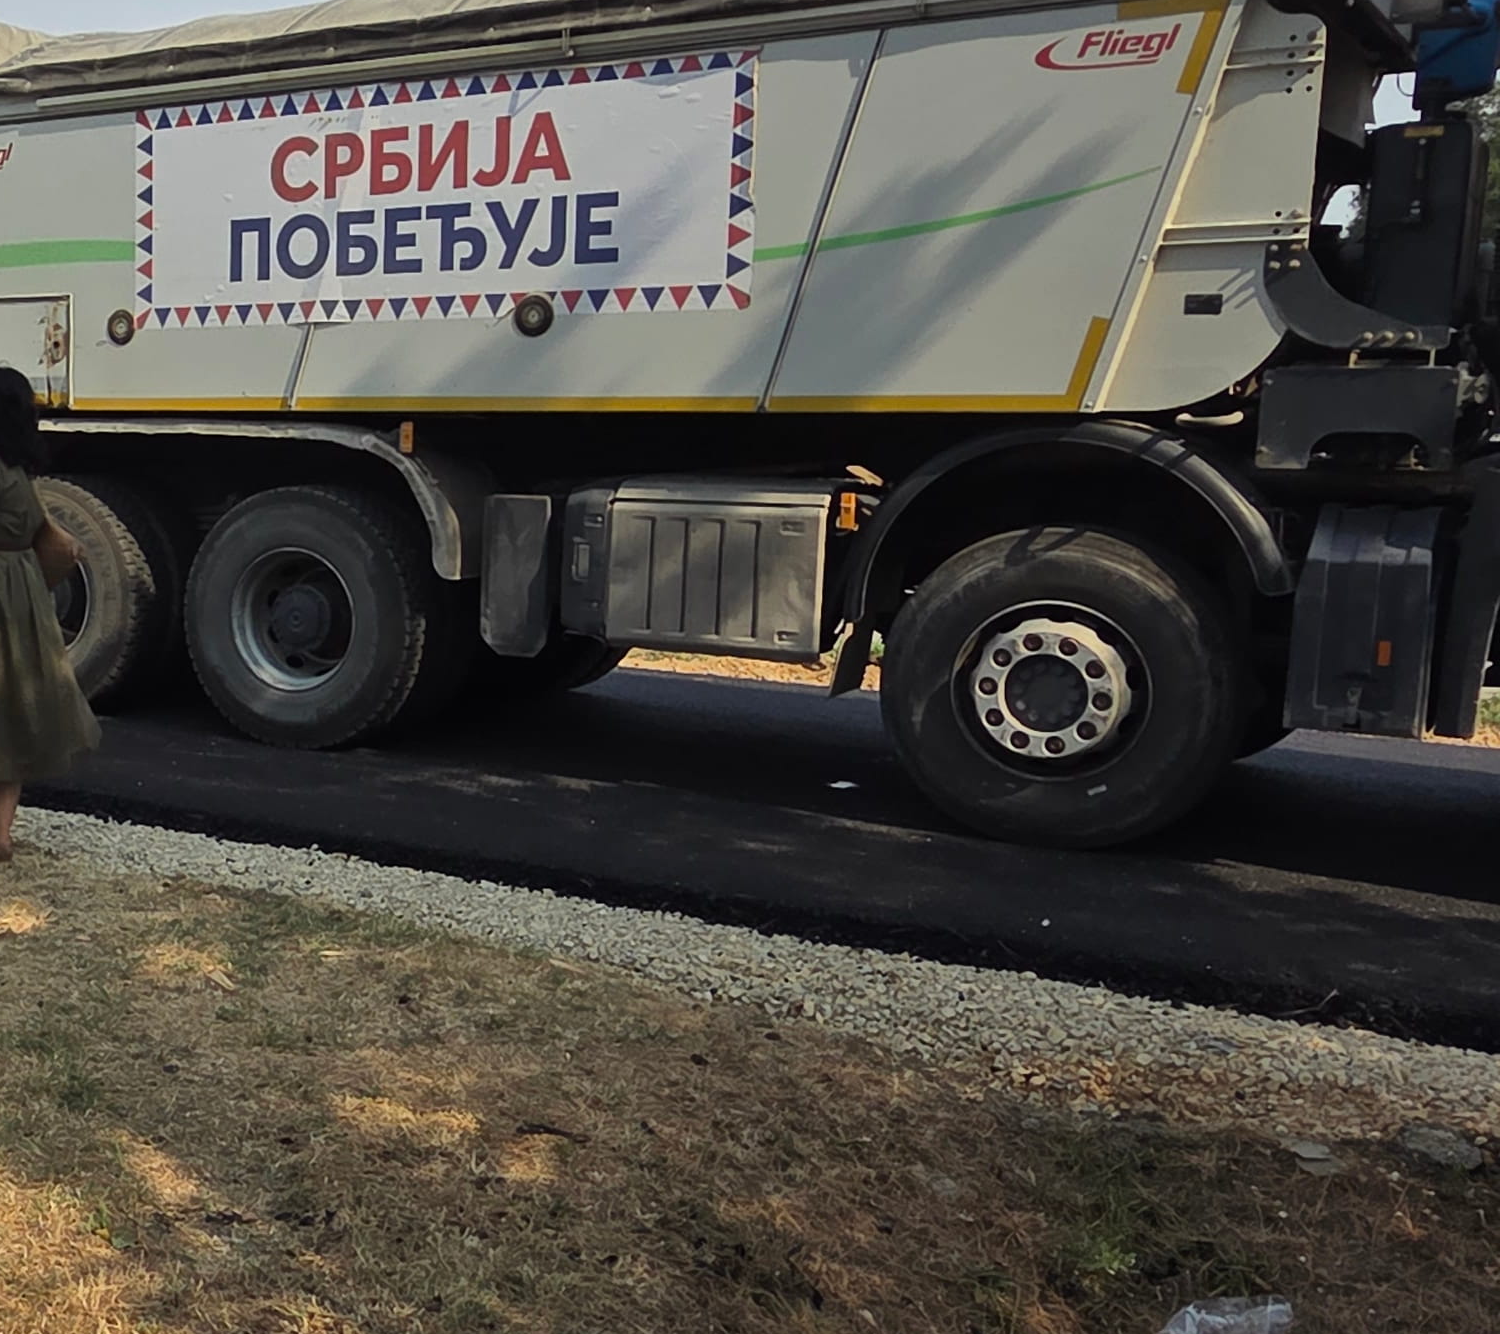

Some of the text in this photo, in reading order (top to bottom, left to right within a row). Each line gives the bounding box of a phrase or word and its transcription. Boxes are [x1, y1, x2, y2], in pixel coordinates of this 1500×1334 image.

[1077, 23, 1182, 59] Fliegl
[270, 111, 572, 203] СРБИЈА
[229, 191, 620, 282] ПОБЕЂУЈЕ
